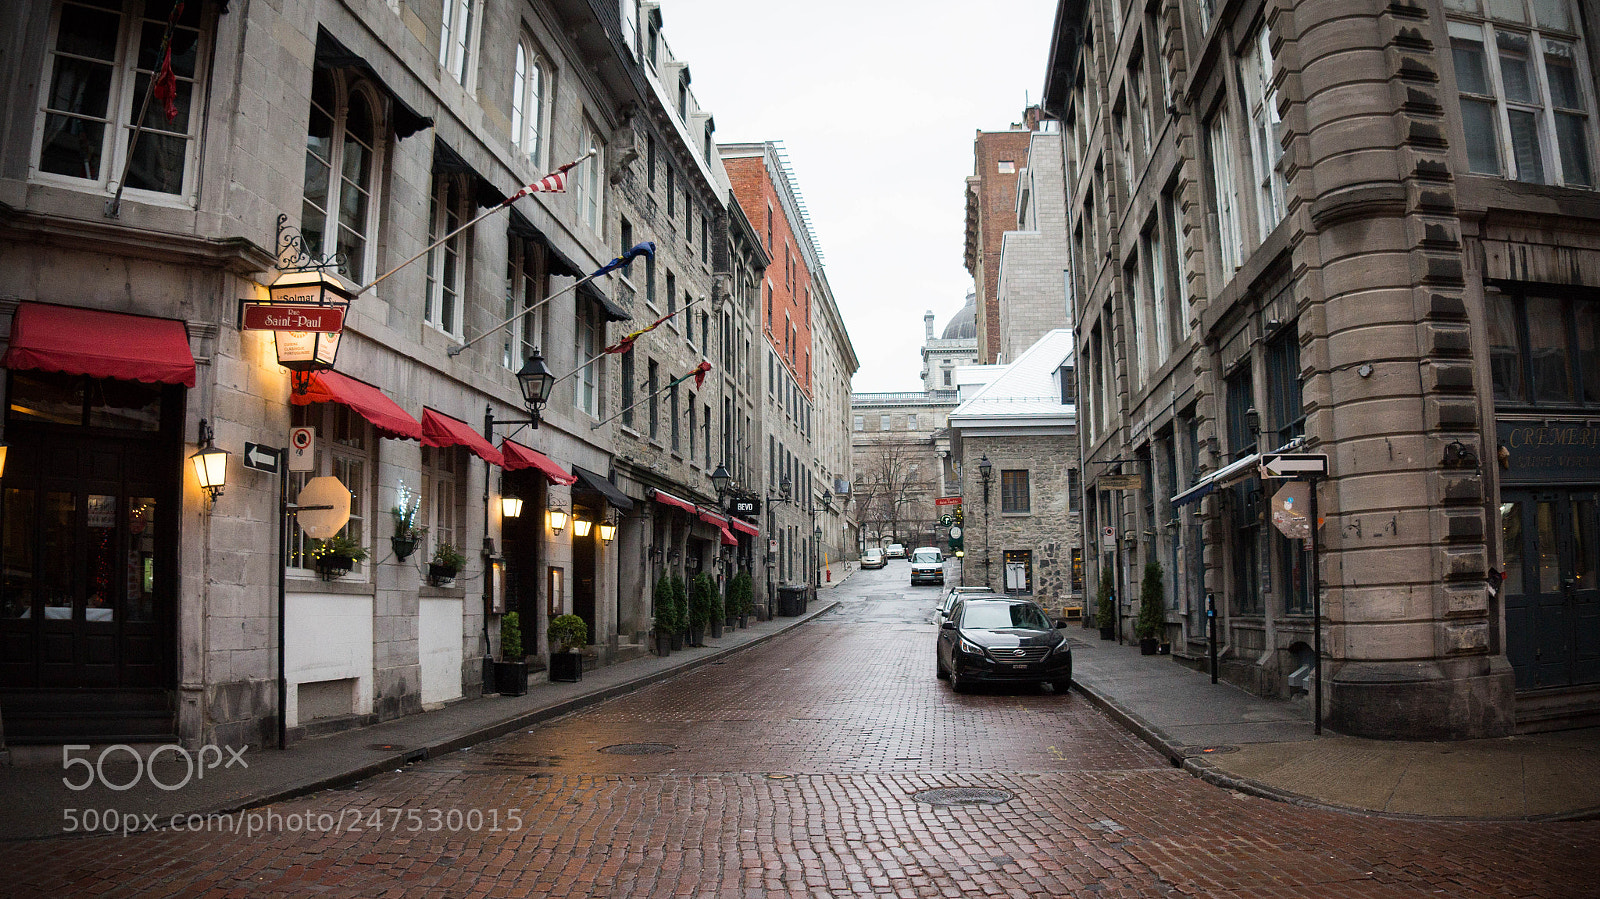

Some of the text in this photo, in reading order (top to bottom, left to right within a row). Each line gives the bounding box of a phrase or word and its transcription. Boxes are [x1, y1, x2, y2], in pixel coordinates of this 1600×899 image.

[283, 294, 314, 303] Solmar
[264, 315, 322, 328] Saint-Paul
[1510, 427, 1600, 448] CREMERI
[737, 503, 753, 511] BEVO
